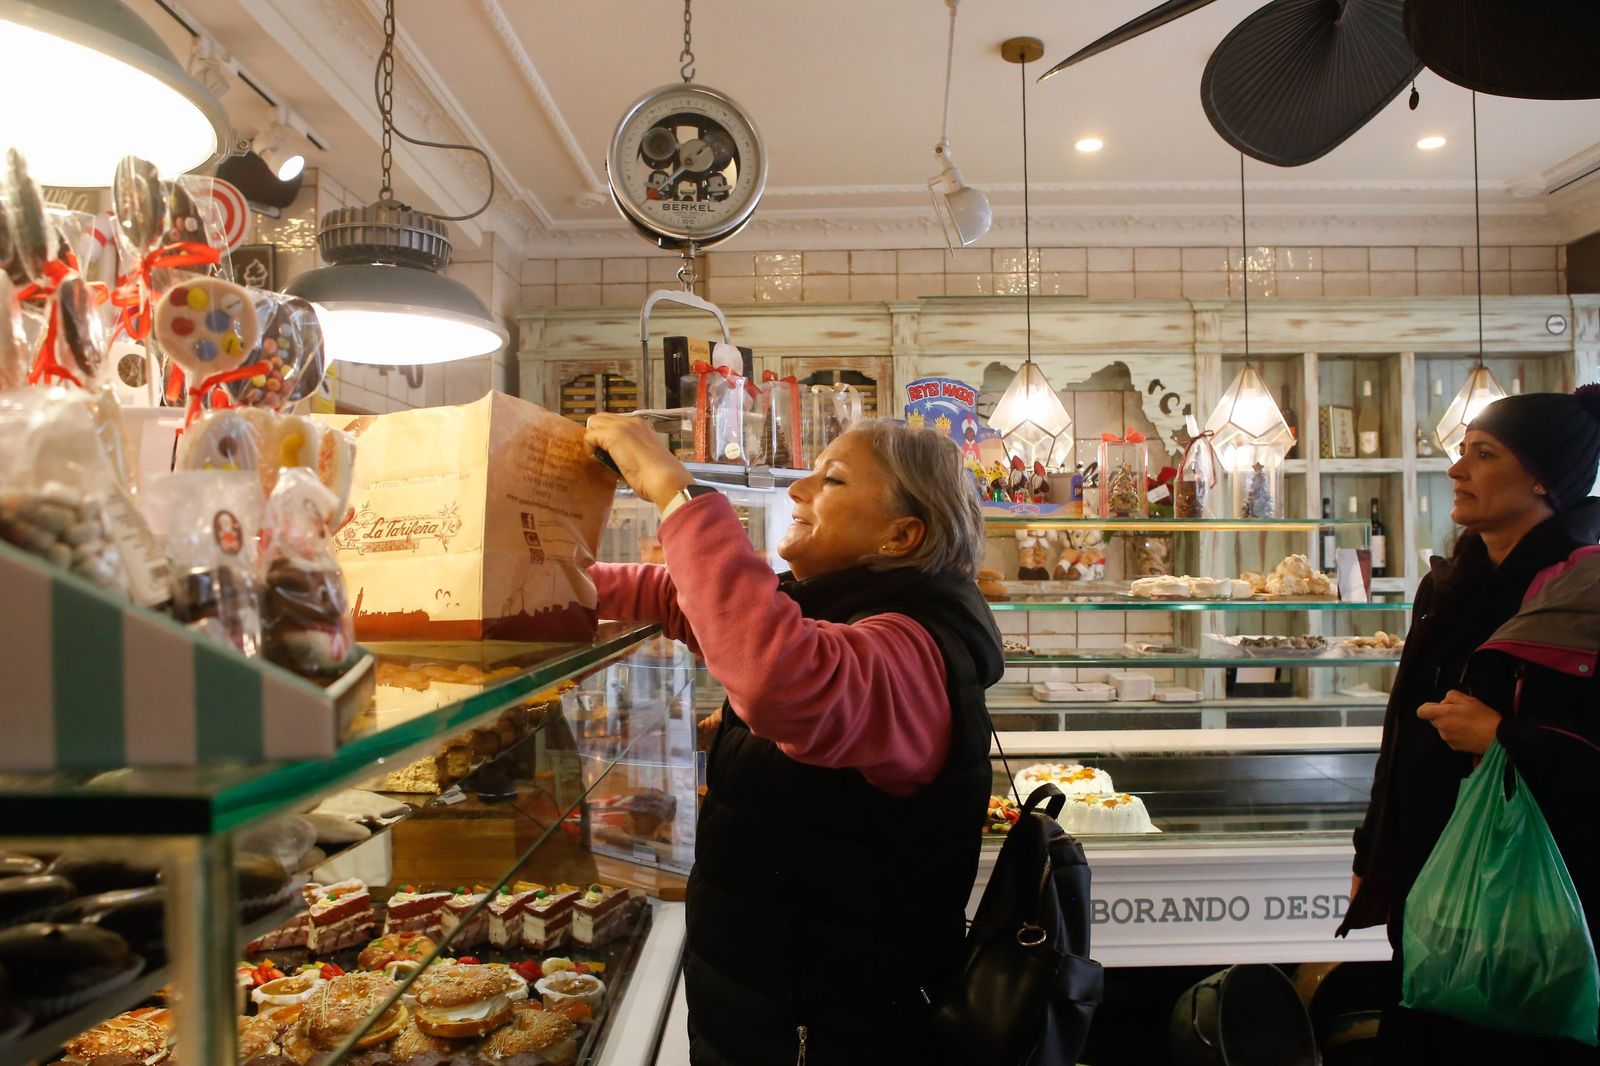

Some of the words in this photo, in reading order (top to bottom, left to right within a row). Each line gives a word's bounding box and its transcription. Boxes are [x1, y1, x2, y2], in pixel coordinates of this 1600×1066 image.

[662, 203, 715, 212] BERKEL
[907, 381, 940, 401] REYES
[941, 382, 975, 406] MAGOS
[362, 517, 385, 539] La
[385, 519, 439, 542] Tarifeña
[1090, 896, 1250, 925] BORANDO
